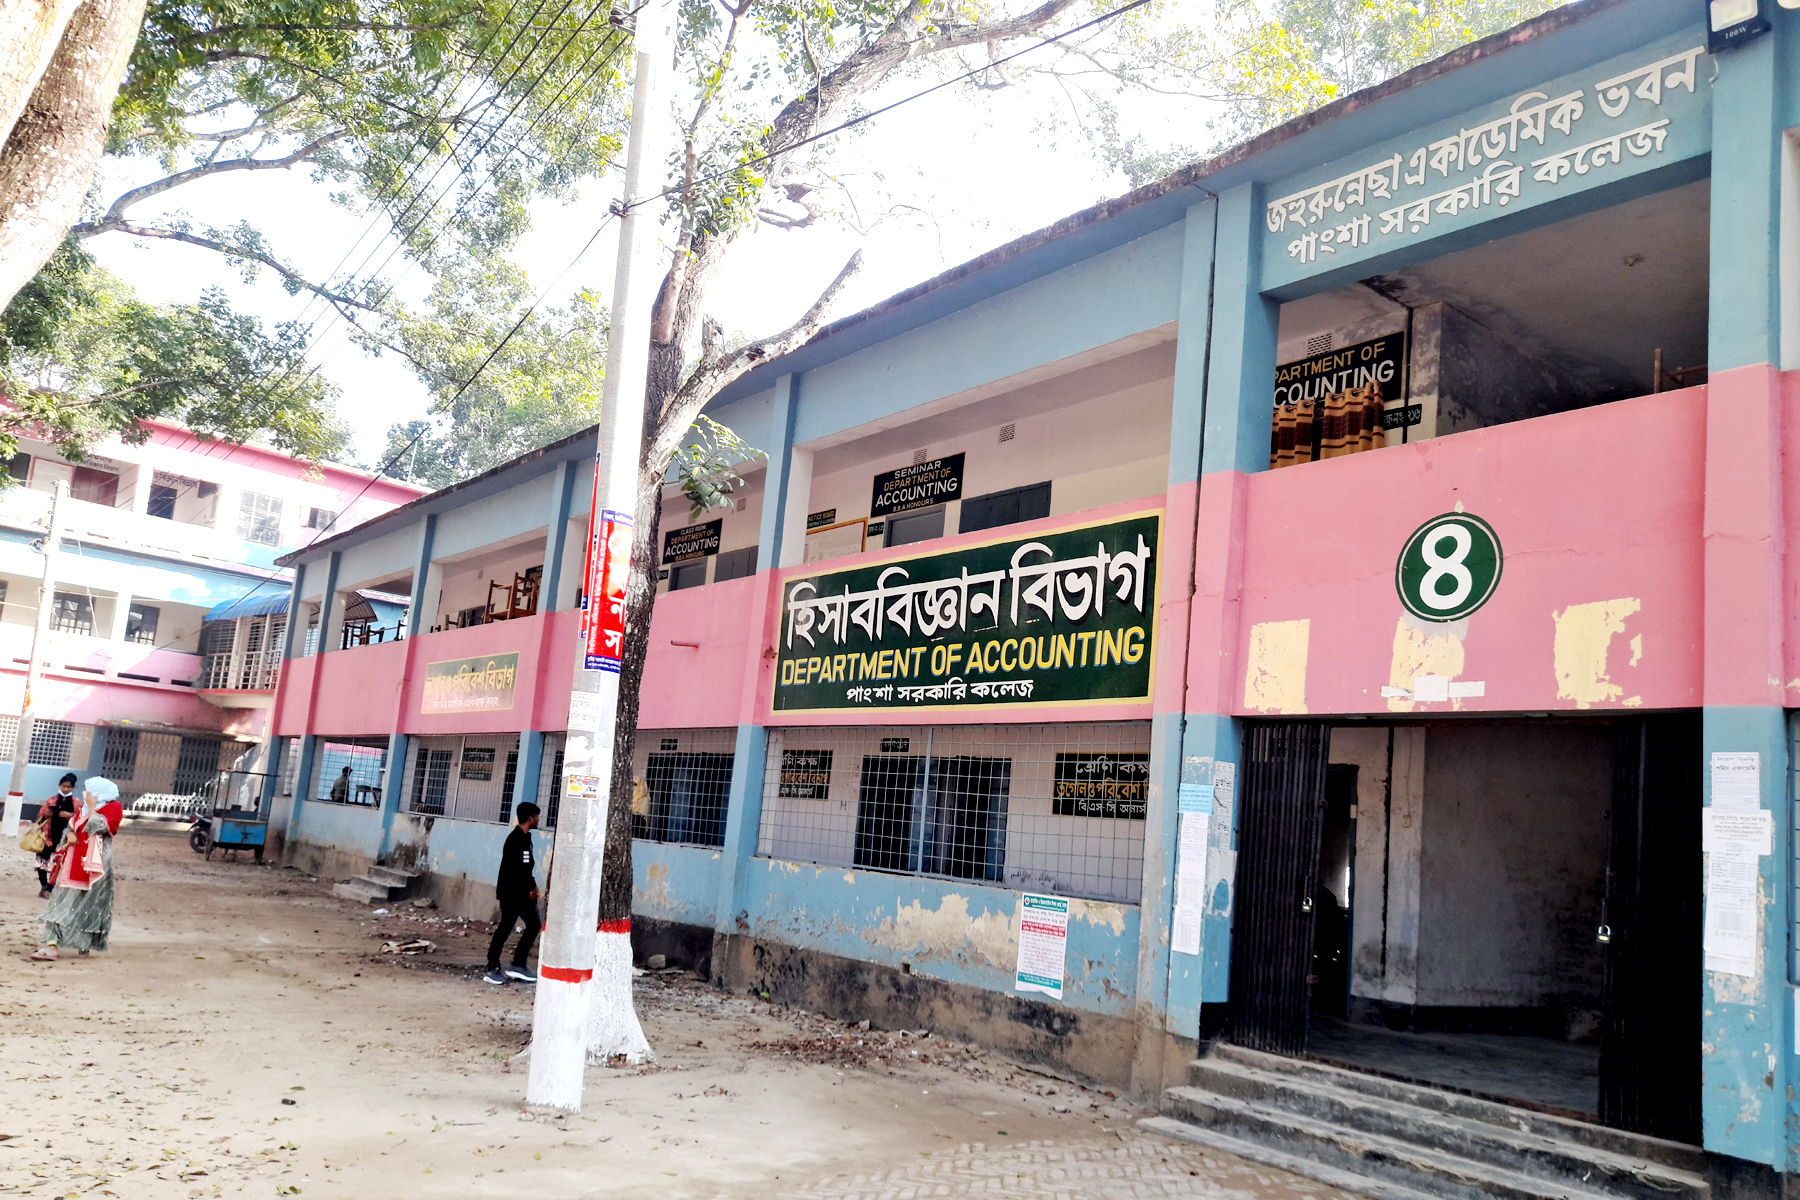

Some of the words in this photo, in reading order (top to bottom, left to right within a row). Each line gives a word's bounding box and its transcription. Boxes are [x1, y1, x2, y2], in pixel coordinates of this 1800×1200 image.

[1725, 26, 1747, 39] 100W
[1266, 153, 1402, 234] জহুরুন্নেছা
[1404, 90, 1585, 187] একাডেমিক
[1595, 45, 1706, 118] ভবন
[1287, 213, 1371, 264] পাংশা
[1380, 160, 1524, 235] সরকারি
[1532, 118, 1671, 184] কলেজ
[1361, 342, 1386, 361] OF
[884, 469, 938, 492] DEPARTMENT
[940, 467, 952, 479] OF
[894, 460, 942, 479] SEMINAR
[876, 478, 958, 508] ACCOUNTING
[906, 498, 934, 510] HONOURS
[670, 532, 706, 545] DEPARTMENT
[680, 528, 694, 536] CLASS
[665, 536, 718, 556] ACCOUNTING
[1419, 523, 1472, 610] 8
[786, 566, 1006, 651] হিসাববিজ্ঞান
[1009, 533, 1151, 628] বিভাগ
[780, 646, 927, 687] DEPARTMENT
[931, 643, 963, 677] OF
[964, 626, 1145, 675] ACCOUNTING
[486, 660, 514, 691] বিভাগ
[846, 684, 893, 703] পাংশা
[897, 677, 967, 702] সরকারি
[971, 679, 1034, 699] কলেজ
[1056, 781, 1088, 799] ভূগোল
[1096, 777, 1140, 800] পরিবেশ
